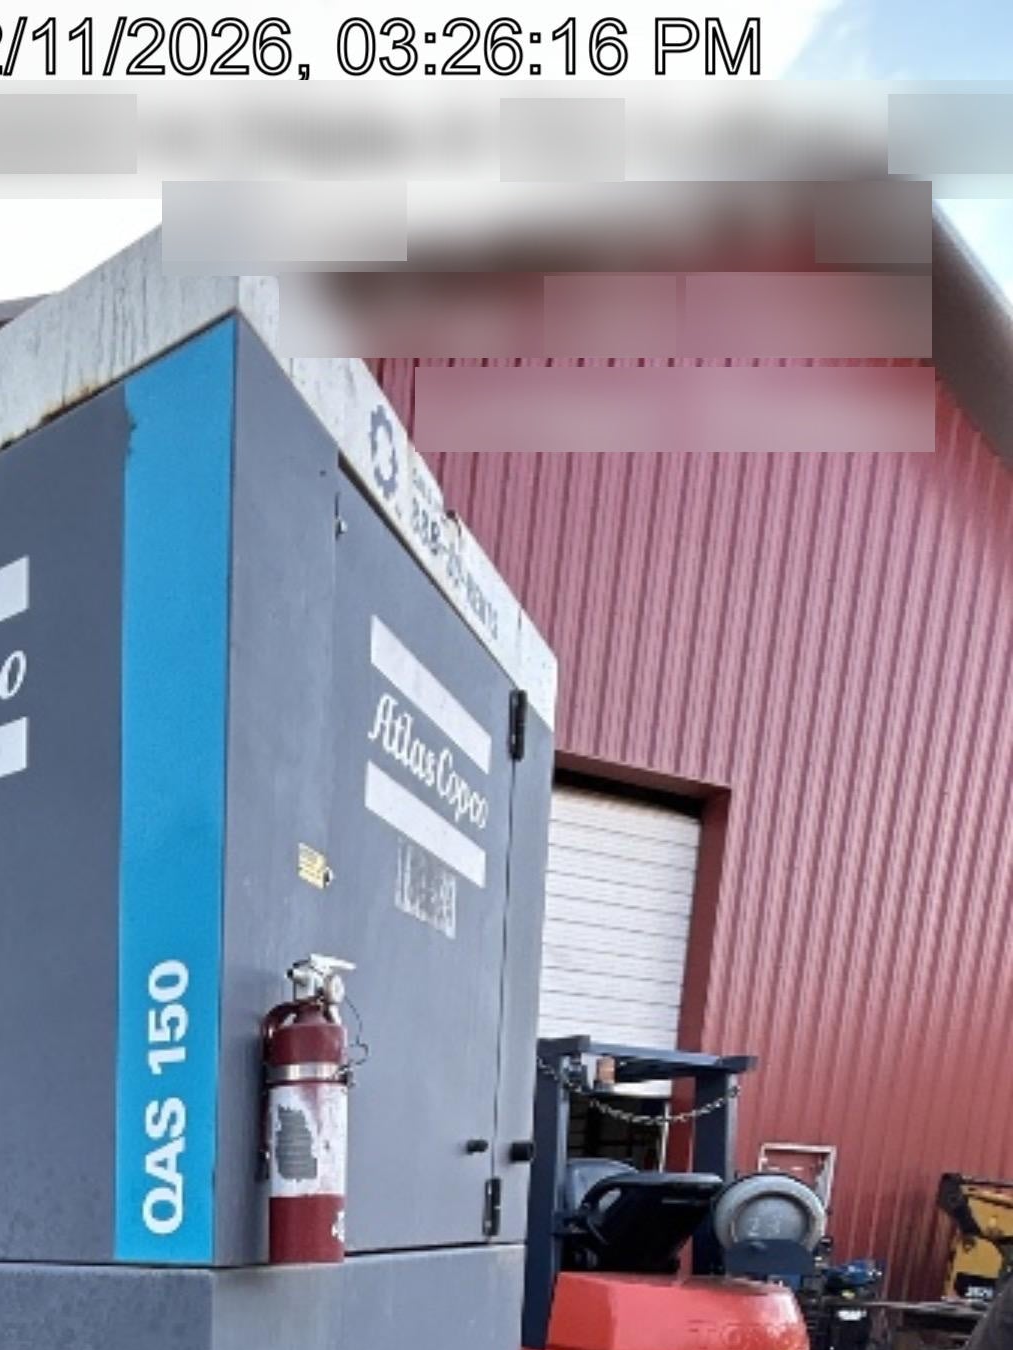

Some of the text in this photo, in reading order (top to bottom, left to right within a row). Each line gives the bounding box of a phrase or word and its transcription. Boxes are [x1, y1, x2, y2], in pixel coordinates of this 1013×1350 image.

[367, 692, 488, 829] Atlas Copco
[142, 959, 189, 1235] QAS 150
